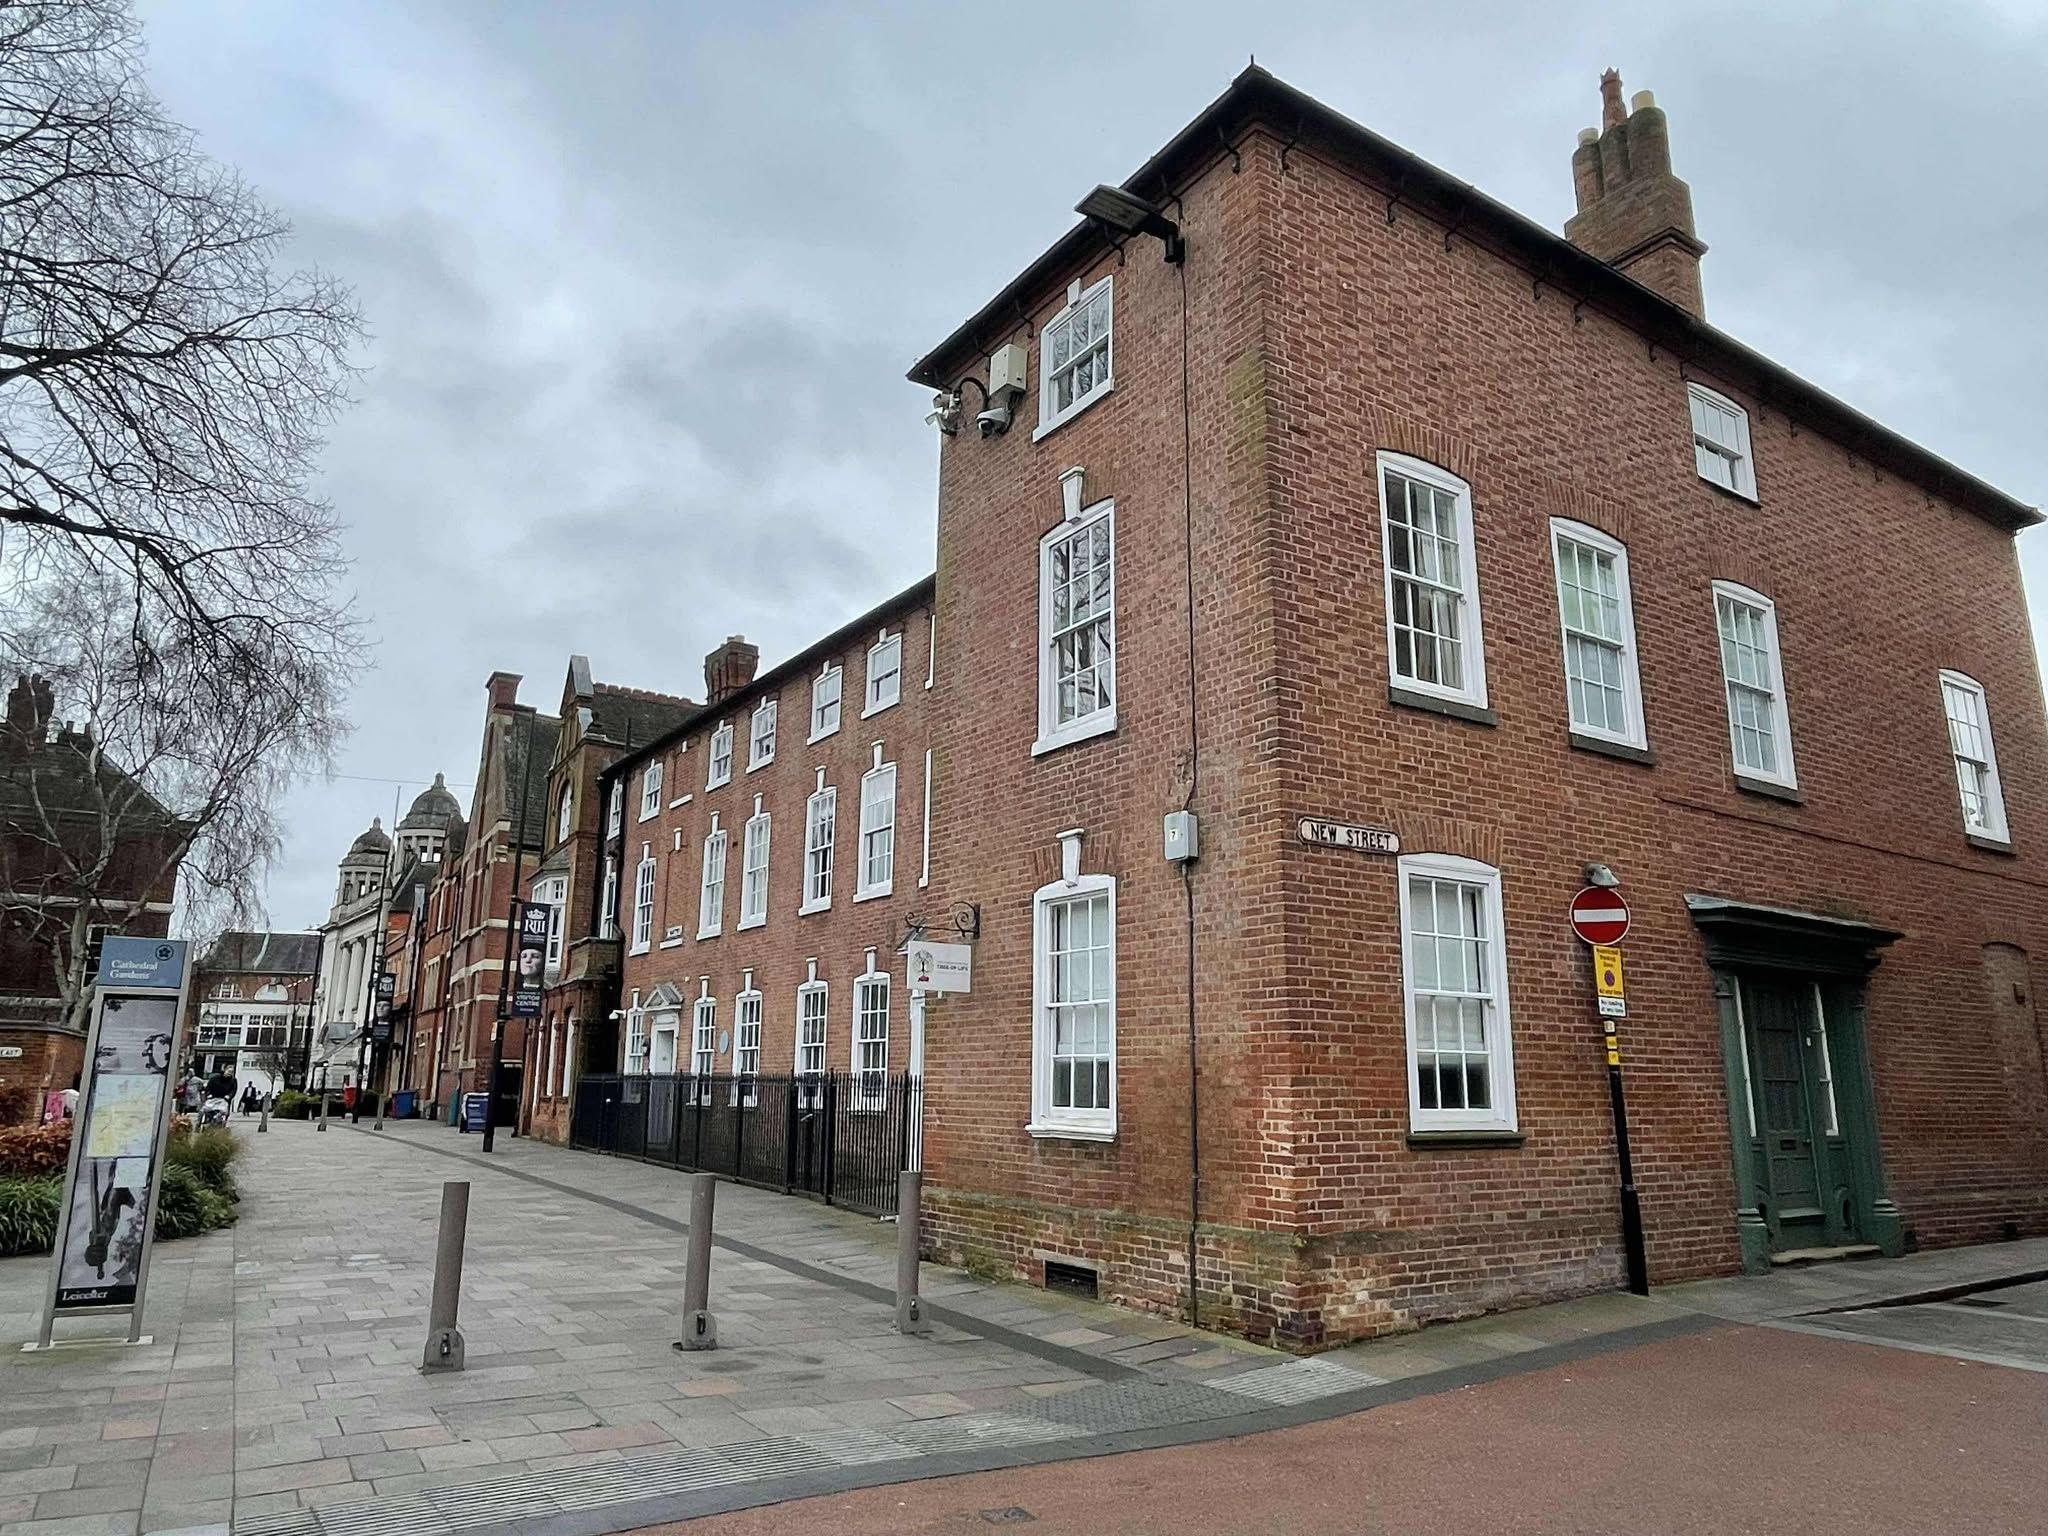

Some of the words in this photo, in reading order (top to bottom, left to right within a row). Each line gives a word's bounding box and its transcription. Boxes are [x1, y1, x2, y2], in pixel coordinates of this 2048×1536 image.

[1171, 831, 1176, 840] 7
[1310, 823, 1337, 843] NEW
[1346, 829, 1391, 850] STREET
[111, 960, 158, 970] Cathedral
[110, 969, 151, 979] Gardens
